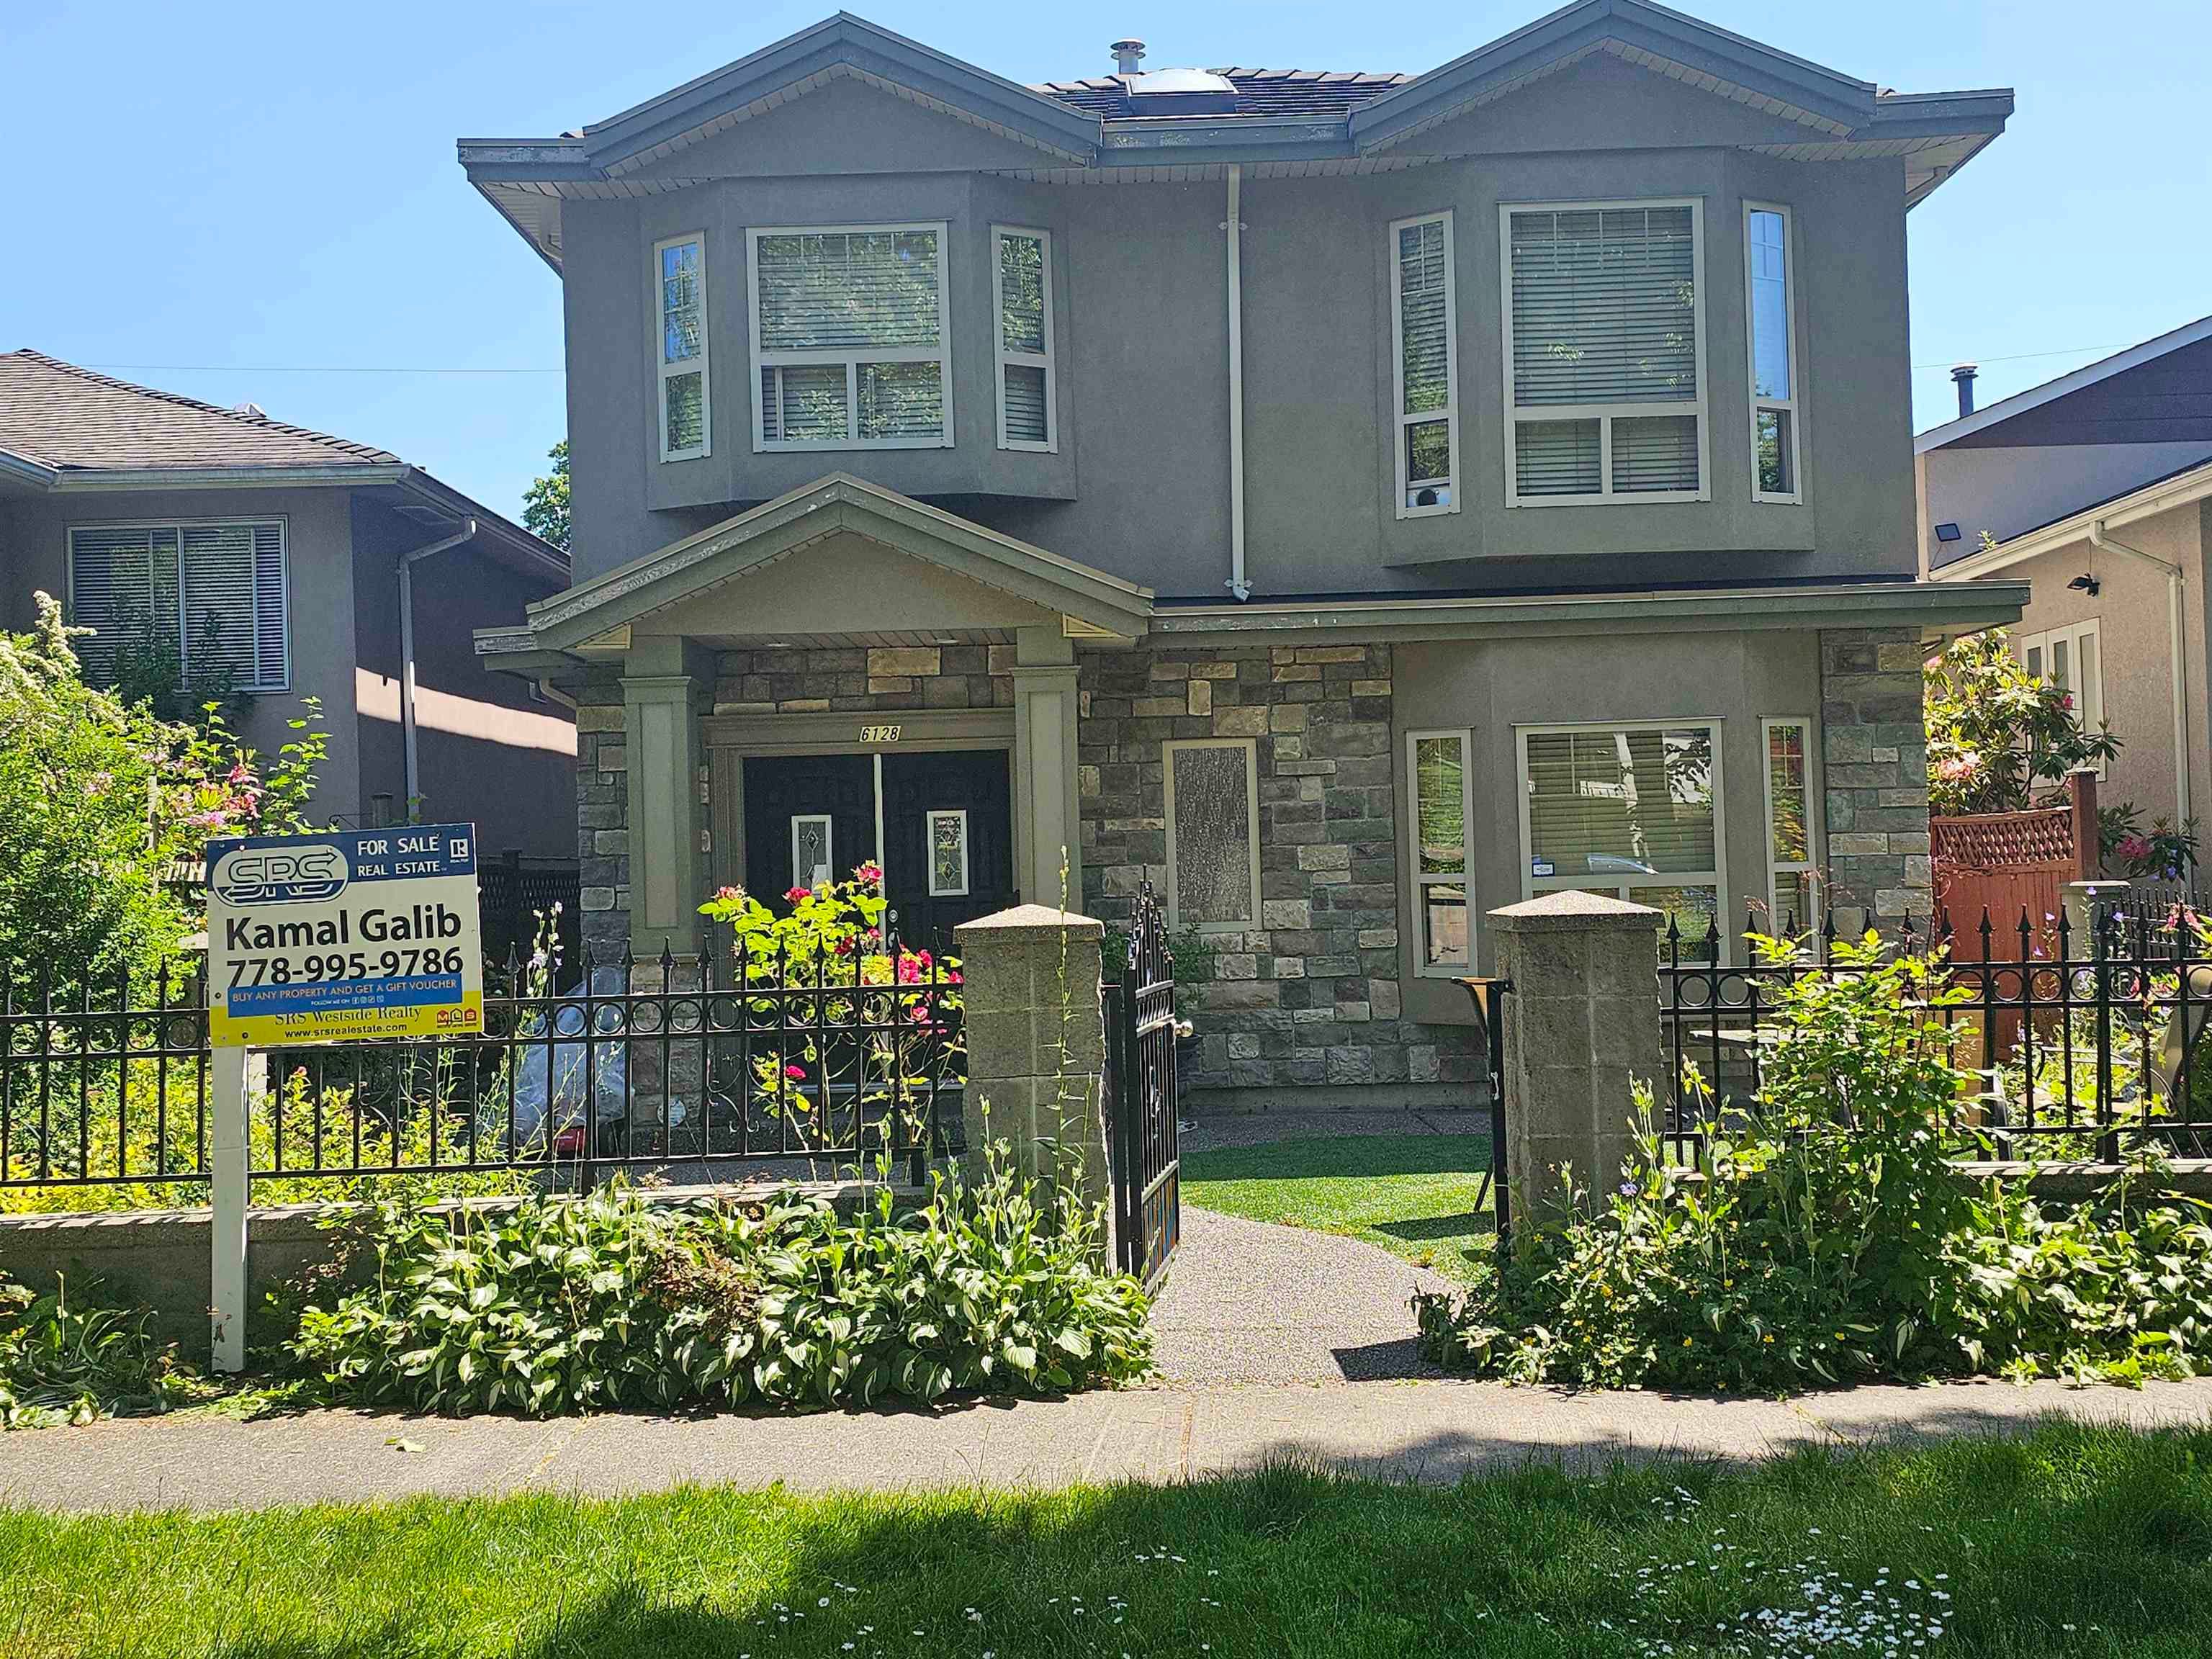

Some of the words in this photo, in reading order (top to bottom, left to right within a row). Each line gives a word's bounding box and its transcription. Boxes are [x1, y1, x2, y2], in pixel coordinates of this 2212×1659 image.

[862, 727, 899, 741] 6128
[357, 839, 389, 857] FOR
[397, 836, 439, 853] SALE
[223, 853, 338, 903] SRS
[358, 864, 388, 878] REAL
[395, 860, 441, 874] ESTATE
[226, 910, 349, 951] Kamal
[359, 904, 462, 942] Galib
[227, 946, 464, 989] 778-995-9786
[233, 992, 253, 1002] BUY
[256, 991, 276, 1000] ANY
[279, 987, 328, 999] PROPERTY
[331, 986, 352, 995] AND
[355, 984, 374, 994] GET
[377, 984, 384, 992] A
[386, 981, 408, 992] GIFT
[409, 979, 457, 990] VOUCHER
[274, 1011, 307, 1025] SRS
[313, 1008, 372, 1023] Westside
[378, 1006, 421, 1022] Realty
[284, 1023, 407, 1038] www.srsrealestate.com
